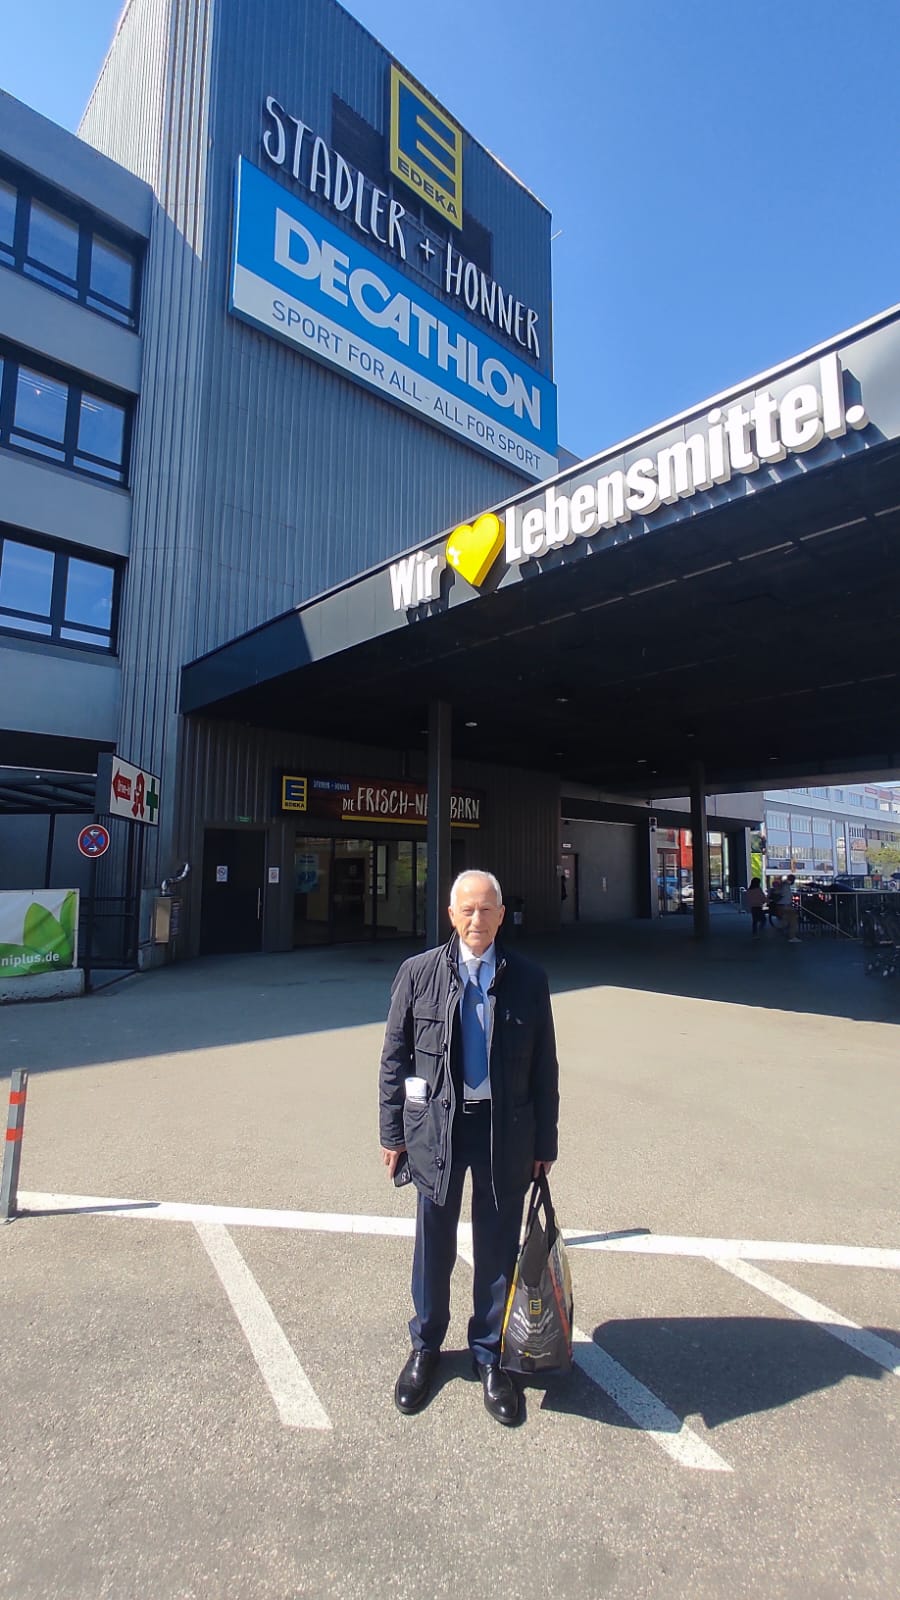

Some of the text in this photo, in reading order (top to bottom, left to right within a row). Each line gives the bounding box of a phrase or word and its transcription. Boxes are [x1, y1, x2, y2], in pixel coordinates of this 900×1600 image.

[262, 95, 407, 260] STADLER
[444, 241, 540, 360] HONNER
[397, 157, 459, 220] EDEKA
[272, 300, 343, 355] SPORT
[348, 343, 385, 378] FOR
[433, 396, 463, 427] ALL
[467, 415, 495, 446] FOR
[498, 434, 541, 470] SPORT
[273, 207, 541, 431] DECATHLON
[388, 350, 871, 612] Wir Lebensmittel.
[342, 797, 355, 812] DIE
